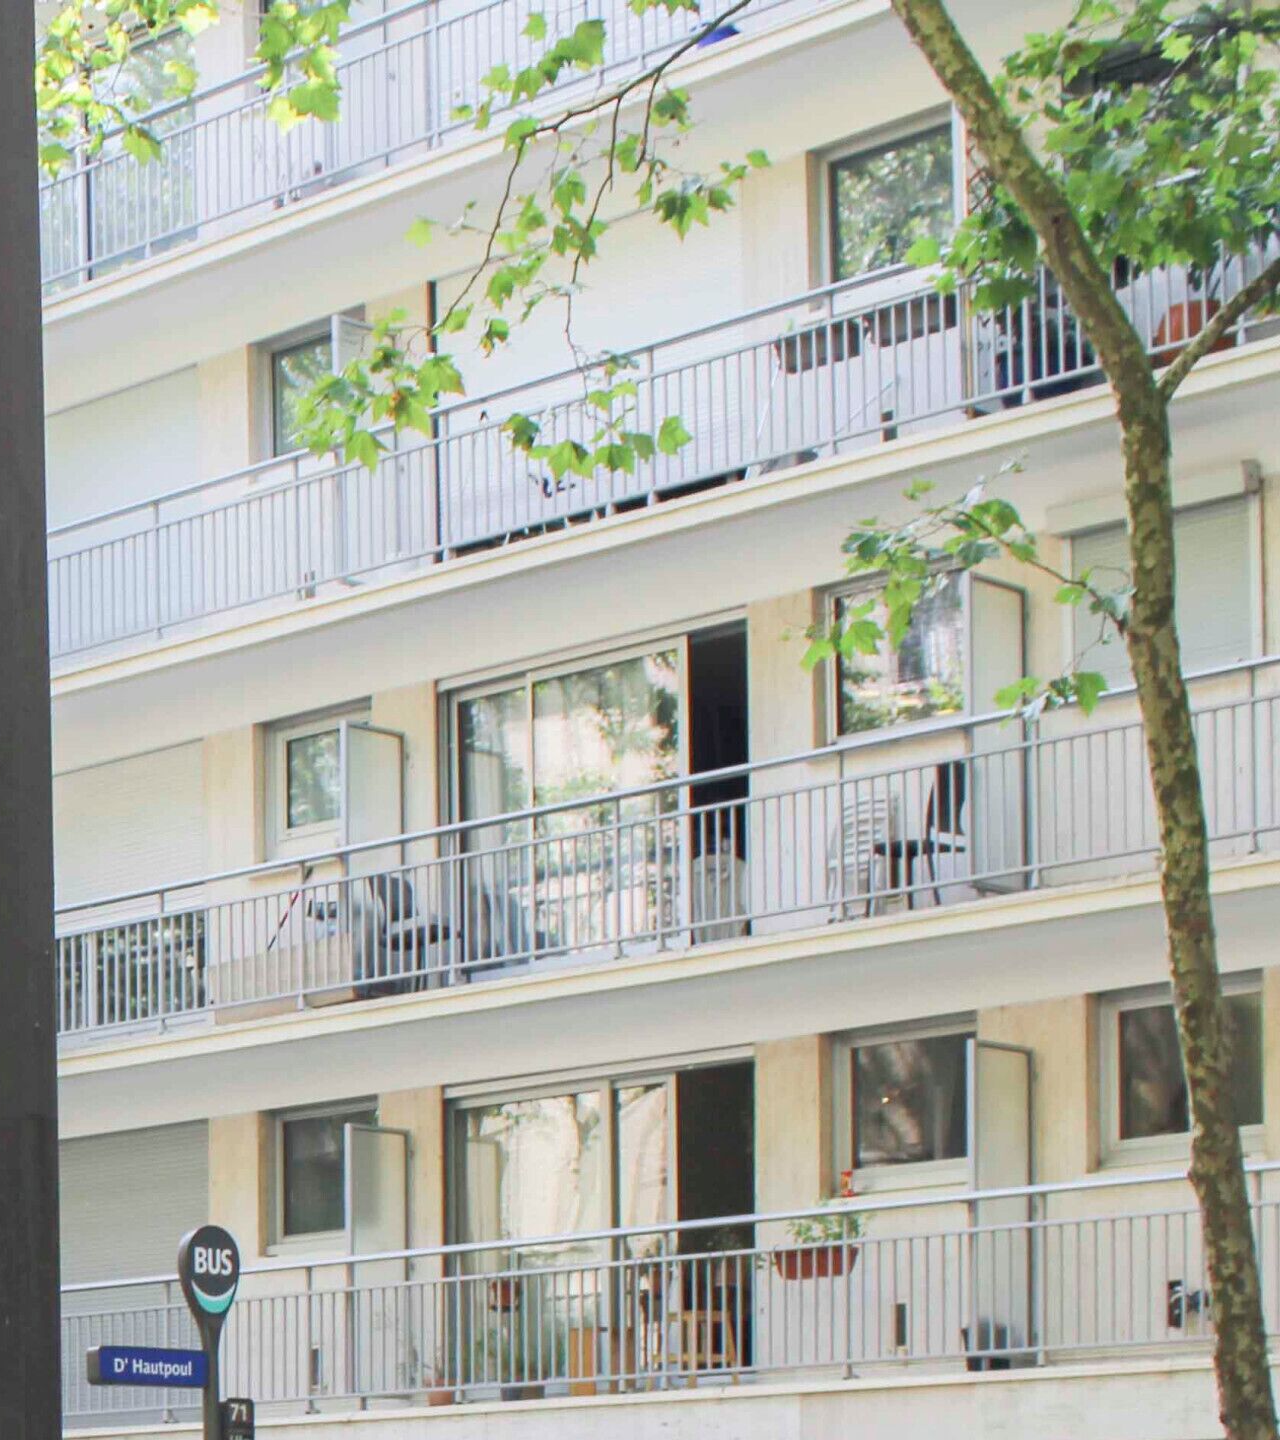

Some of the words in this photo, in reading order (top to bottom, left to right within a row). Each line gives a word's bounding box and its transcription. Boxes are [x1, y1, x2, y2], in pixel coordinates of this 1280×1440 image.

[193, 1246, 233, 1276] BUS
[132, 1358, 193, 1378] Hautpoul
[230, 1403, 248, 1421] 71
